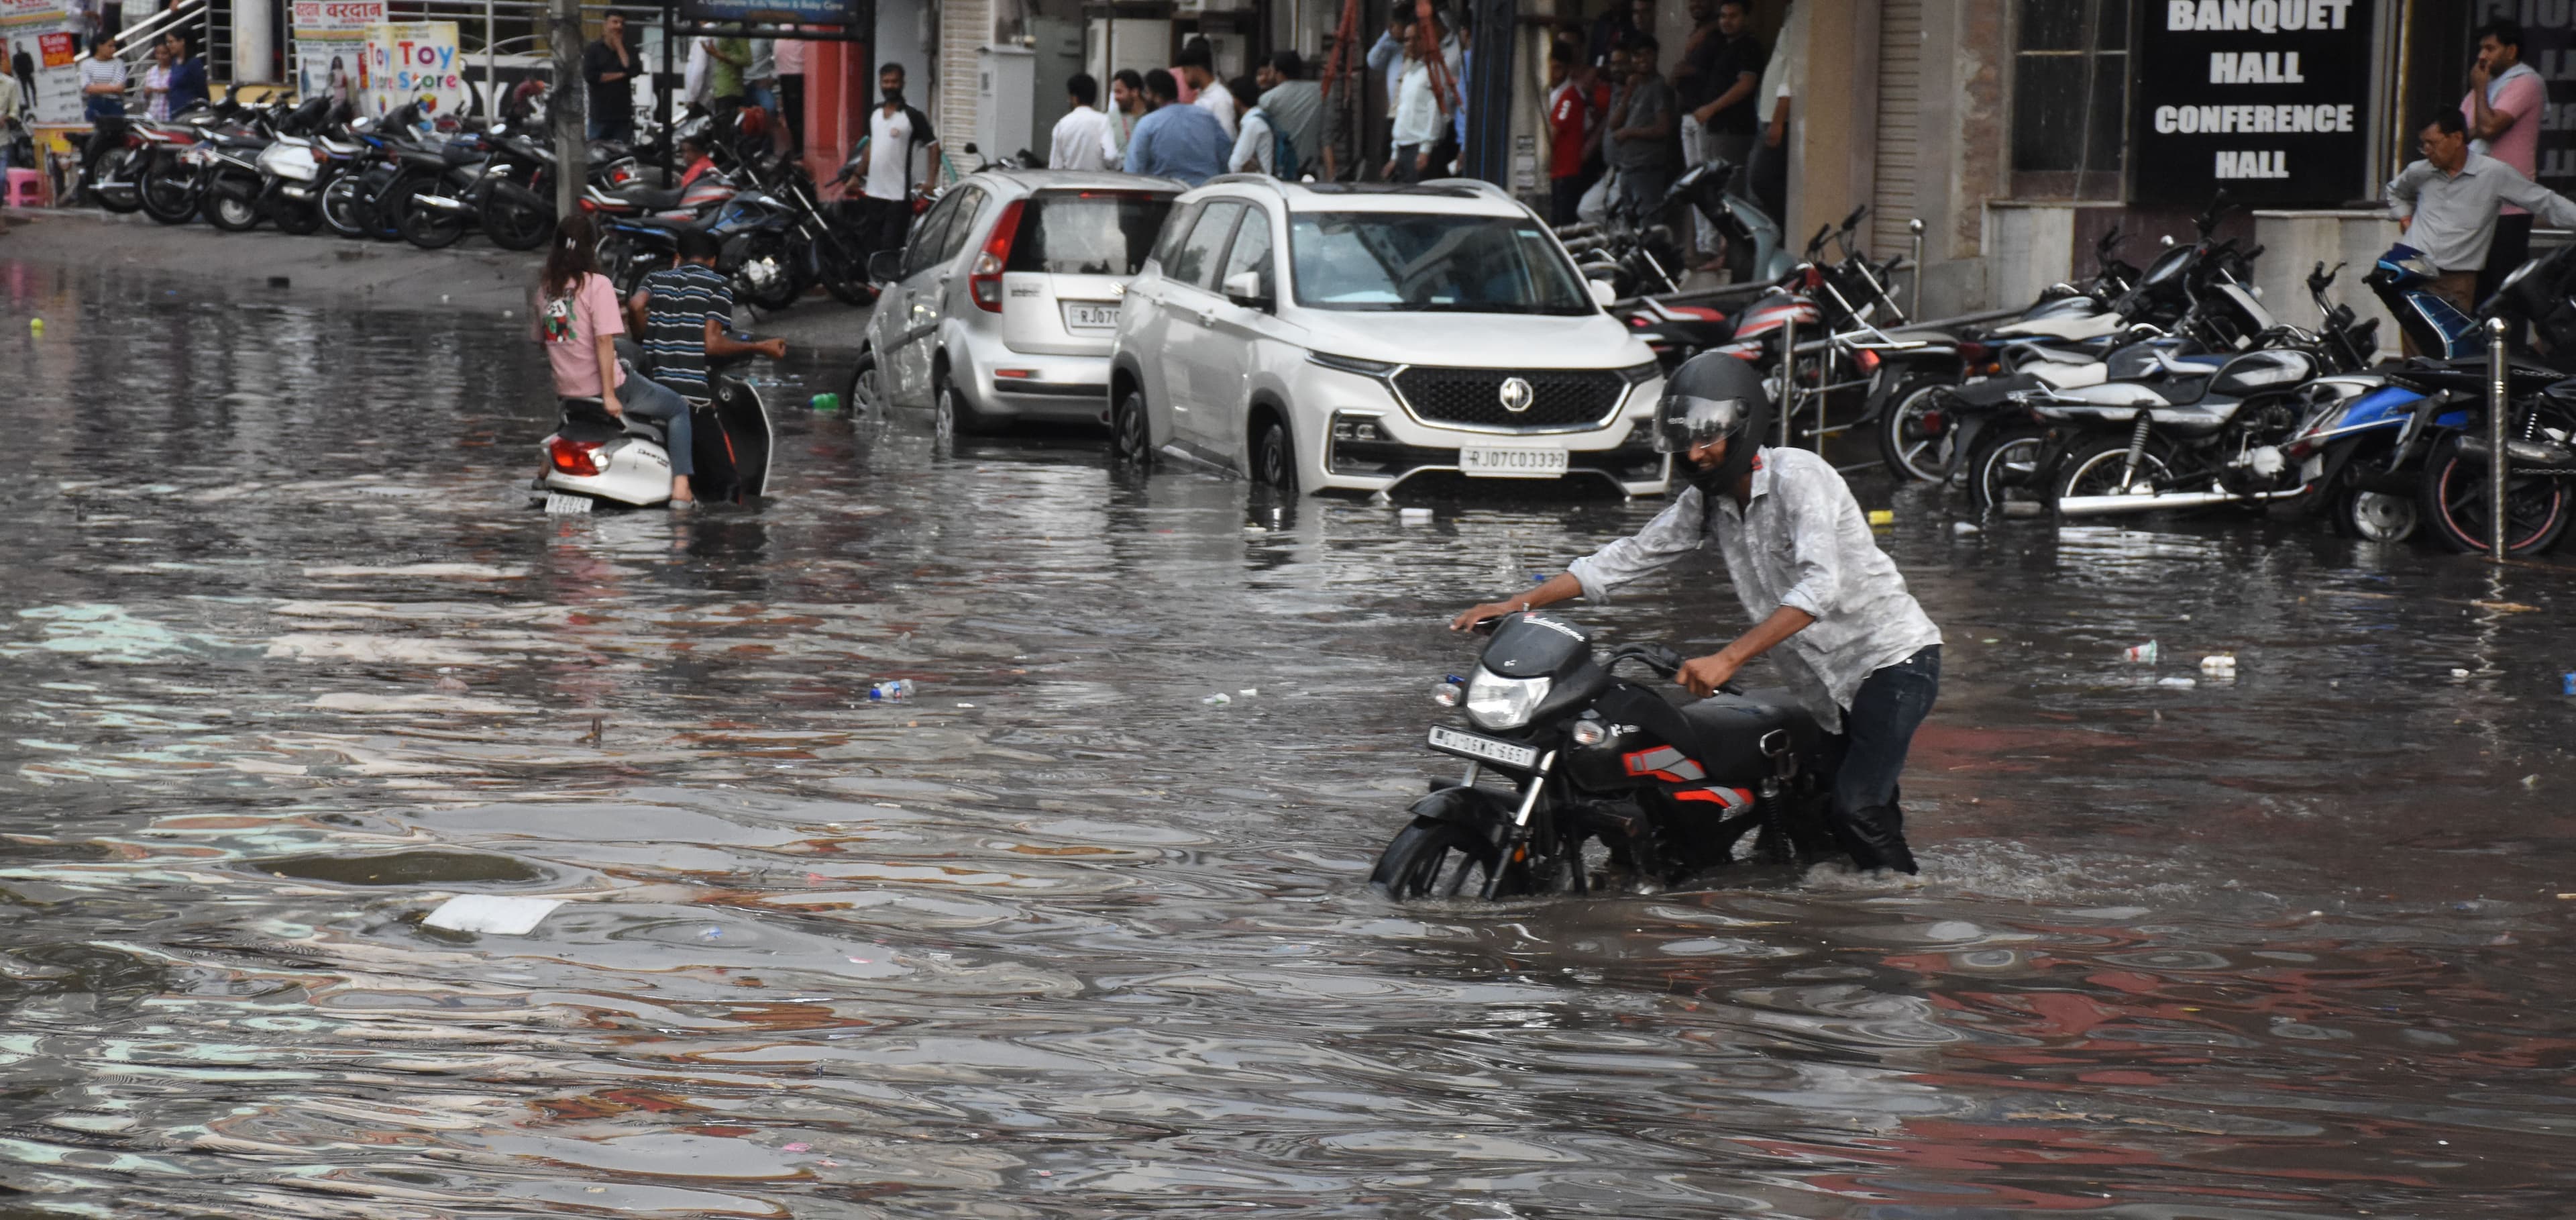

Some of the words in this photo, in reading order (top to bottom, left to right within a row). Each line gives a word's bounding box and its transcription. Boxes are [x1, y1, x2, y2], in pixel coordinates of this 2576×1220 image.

[325, 3, 382, 17] वरदान
[2167, 0, 2353, 34] BANQUET
[398, 41, 455, 70] Toy
[2210, 51, 2305, 84] HALL
[2155, 103, 2354, 134] CONFERENCE
[2216, 150, 2290, 179] HALL
